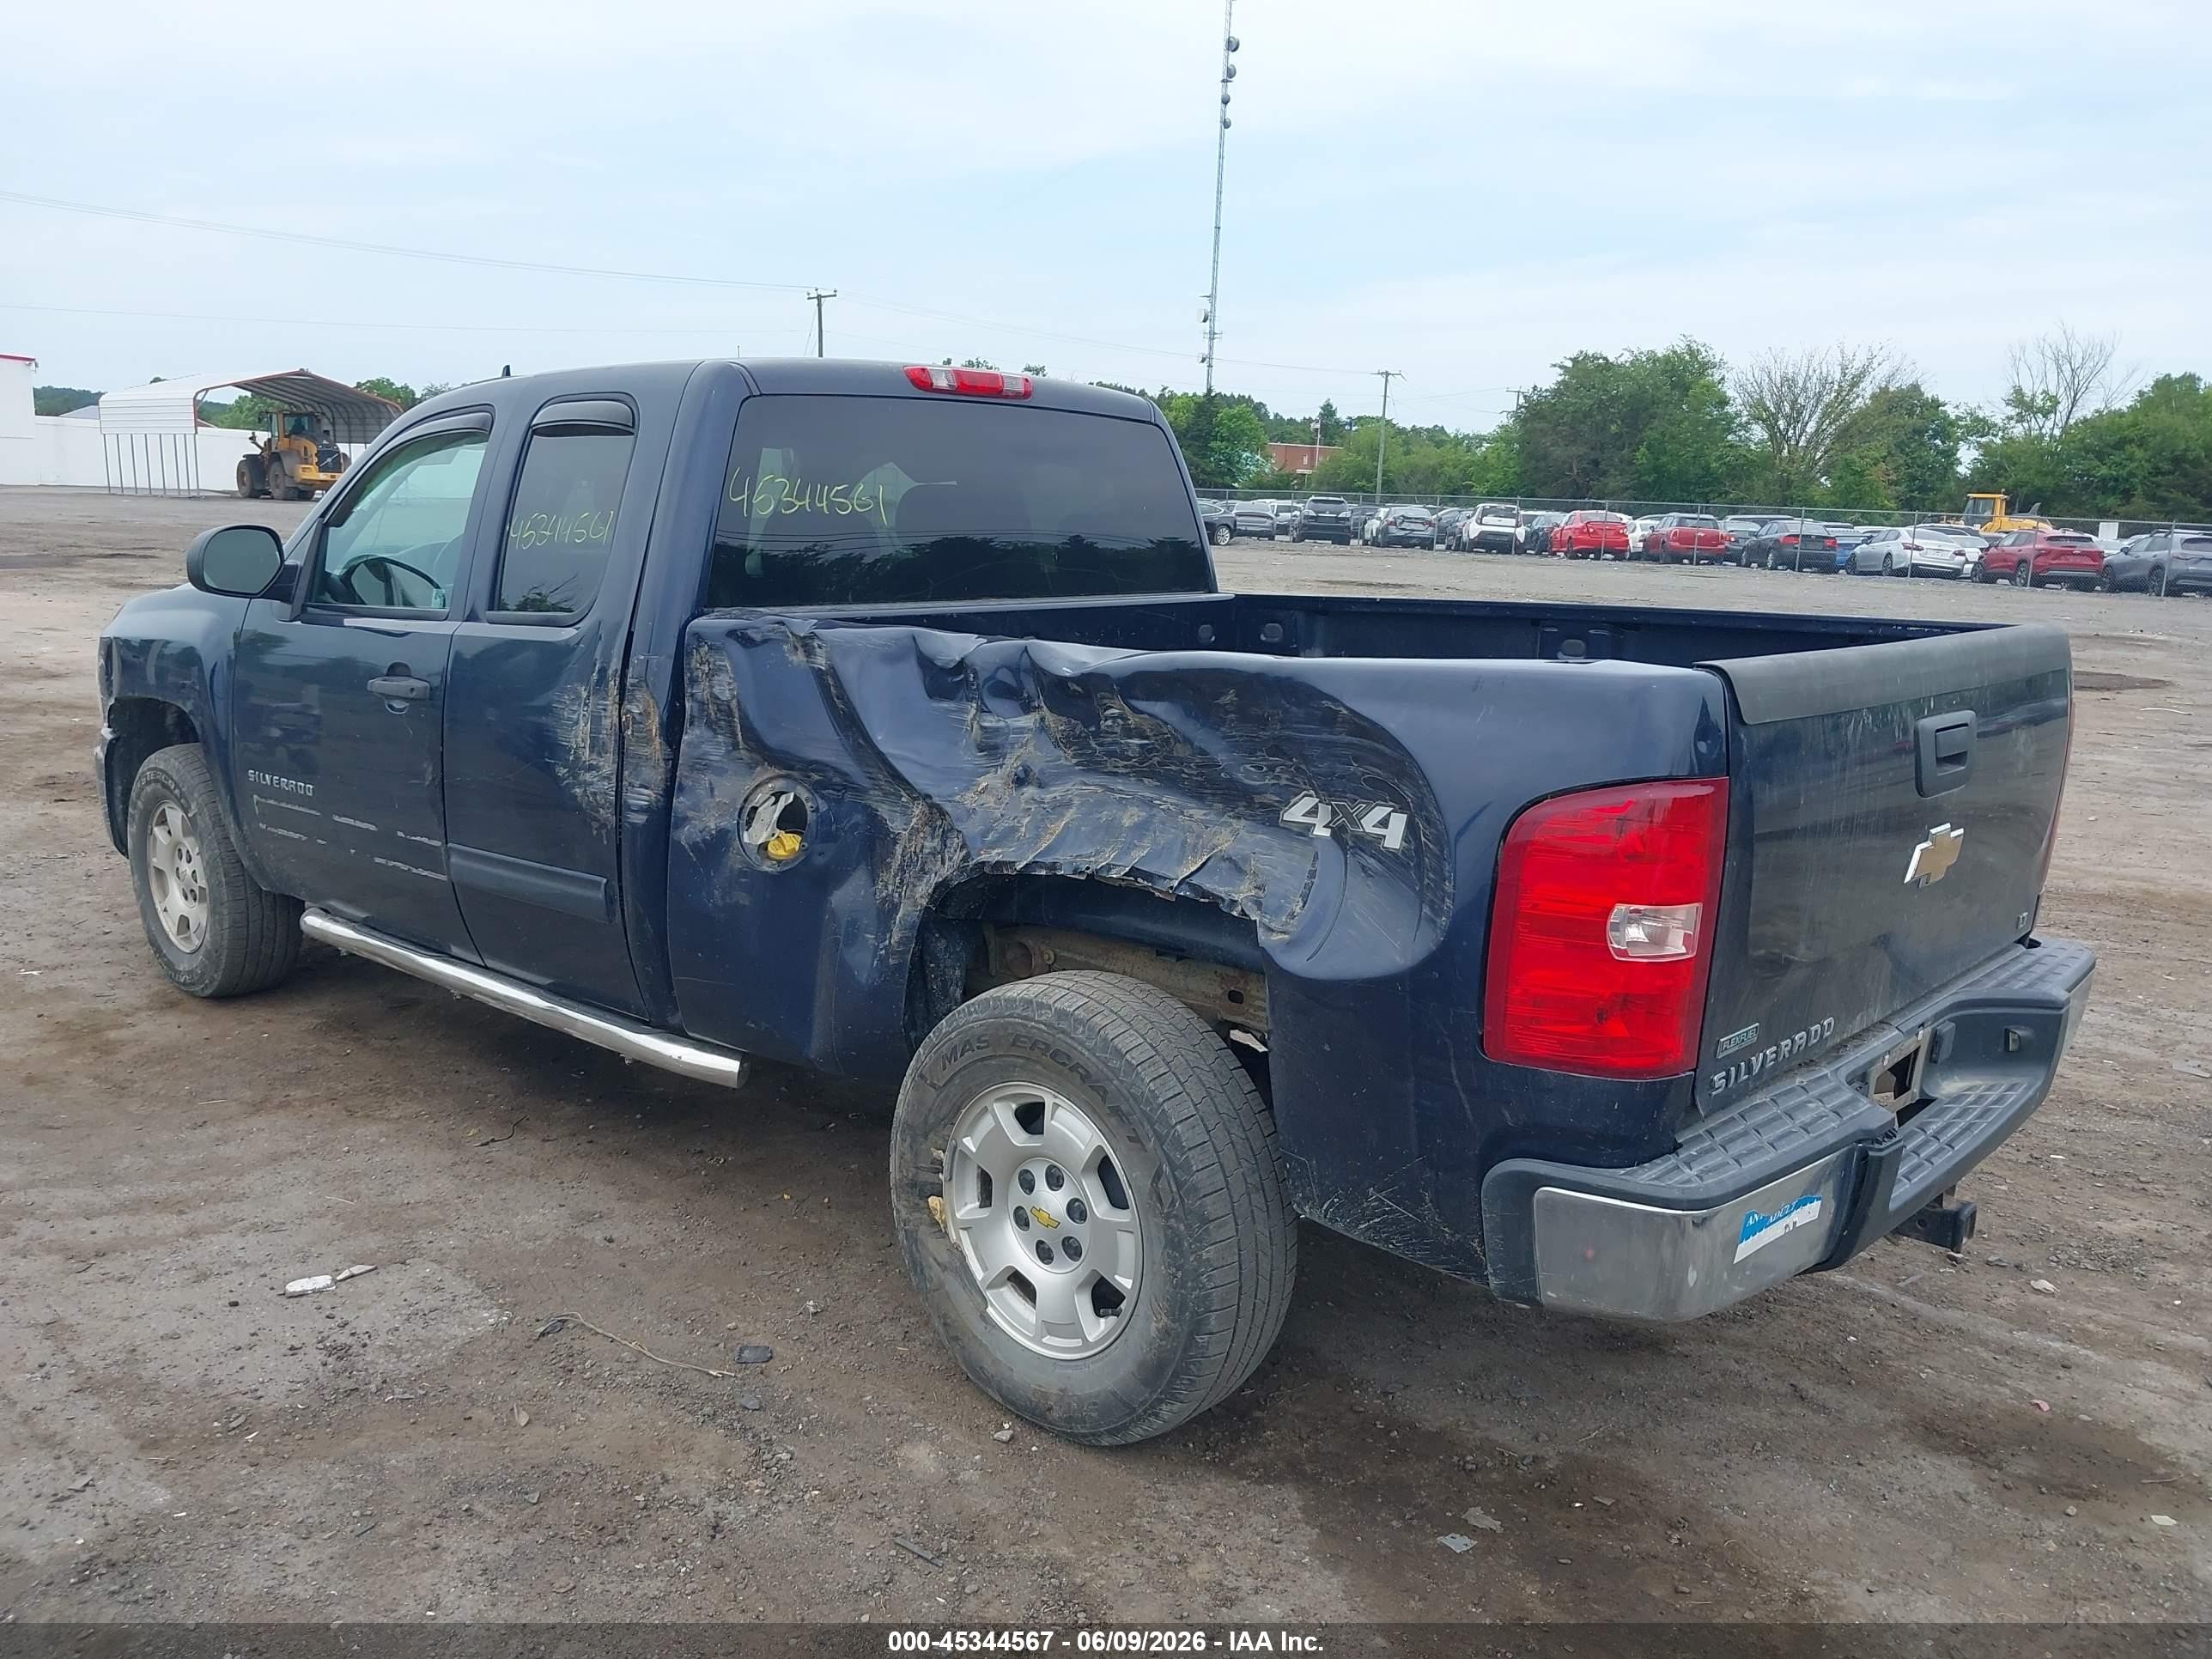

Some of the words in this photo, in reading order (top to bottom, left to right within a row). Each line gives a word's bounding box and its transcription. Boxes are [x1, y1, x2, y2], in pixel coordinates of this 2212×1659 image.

[248, 769, 314, 797] SILVERADO
[1722, 1029, 1758, 1051] FLEXFUEL
[1710, 1017, 1835, 1097] SILVERADO
